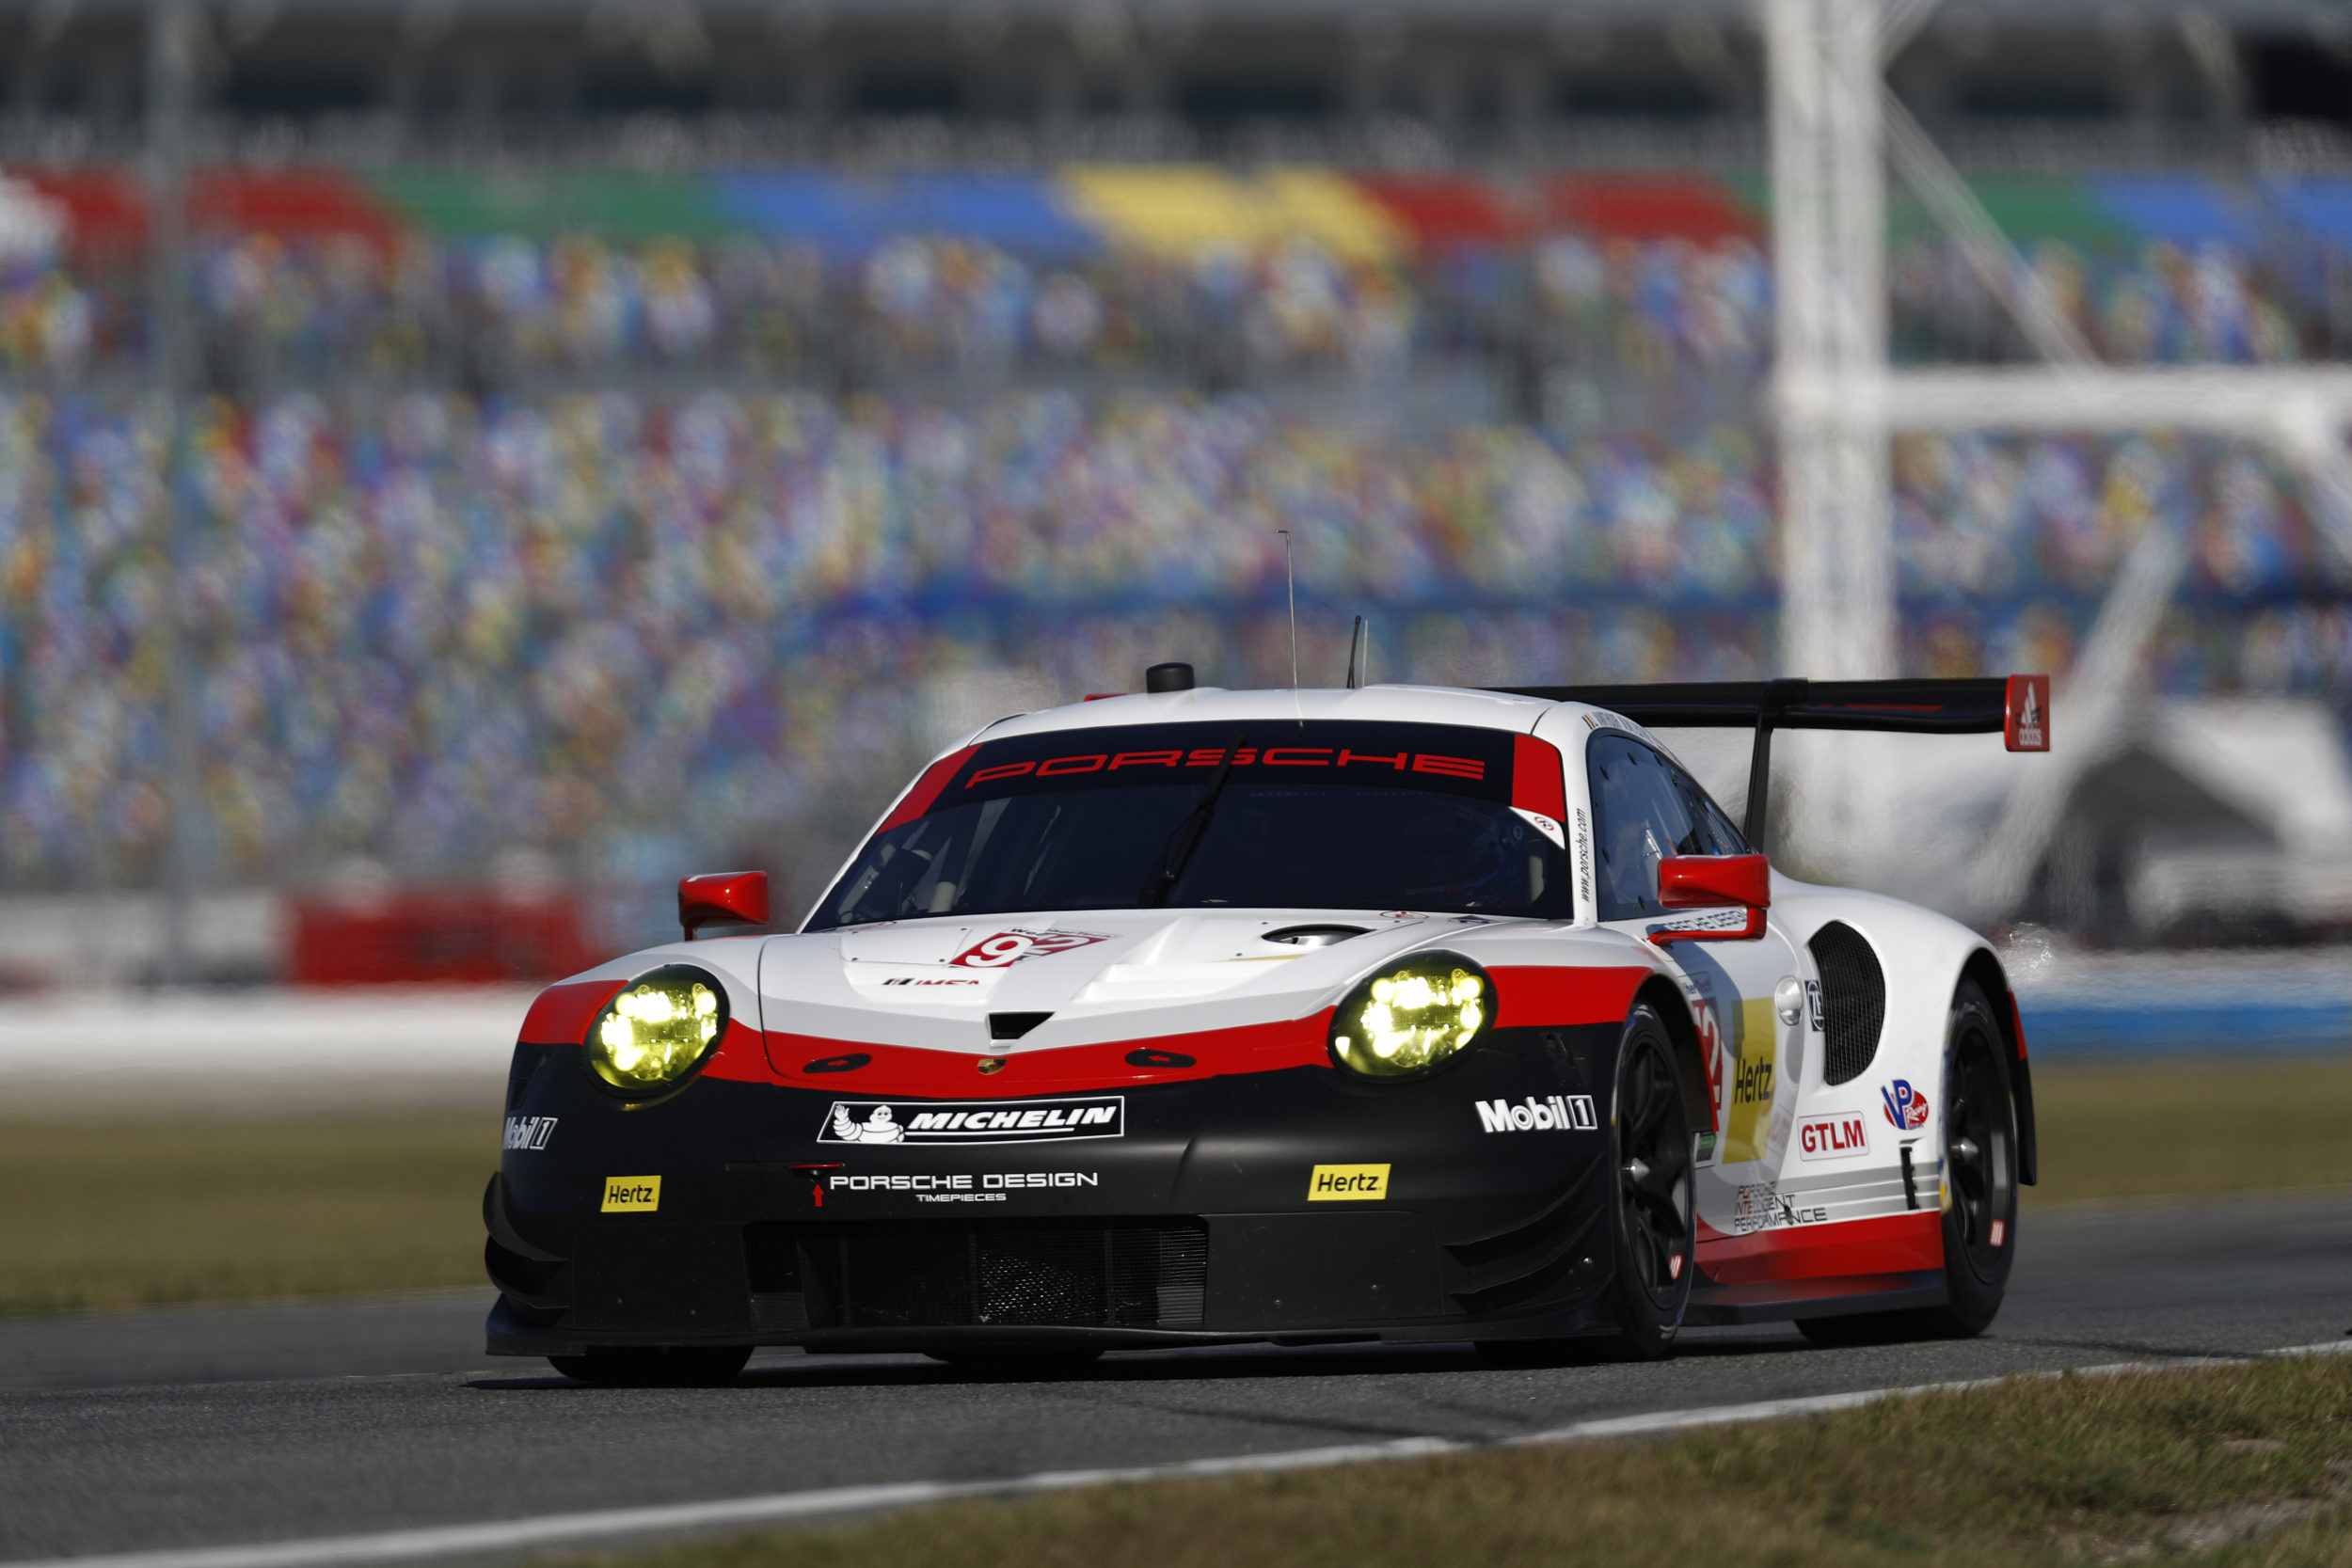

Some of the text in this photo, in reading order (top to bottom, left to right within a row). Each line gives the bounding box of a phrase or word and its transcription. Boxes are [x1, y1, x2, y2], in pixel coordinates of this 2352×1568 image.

[964, 748, 1484, 788] PORSCHE
[1576, 807, 1591, 903] www.porsche.com
[1734, 1056, 1772, 1104] Hertz
[908, 1105, 1117, 1130] MICHELIN
[1474, 1095, 1571, 1132] Mobil
[1881, 1079, 1913, 1131] VP
[1802, 1119, 1866, 1153] GTLM
[608, 1184, 654, 1204] Hertz
[830, 1172, 1098, 1190] PORSCHE DESIGN
[915, 1193, 1007, 1203] TIMEPIECES
[1317, 1172, 1379, 1192] Hertz
